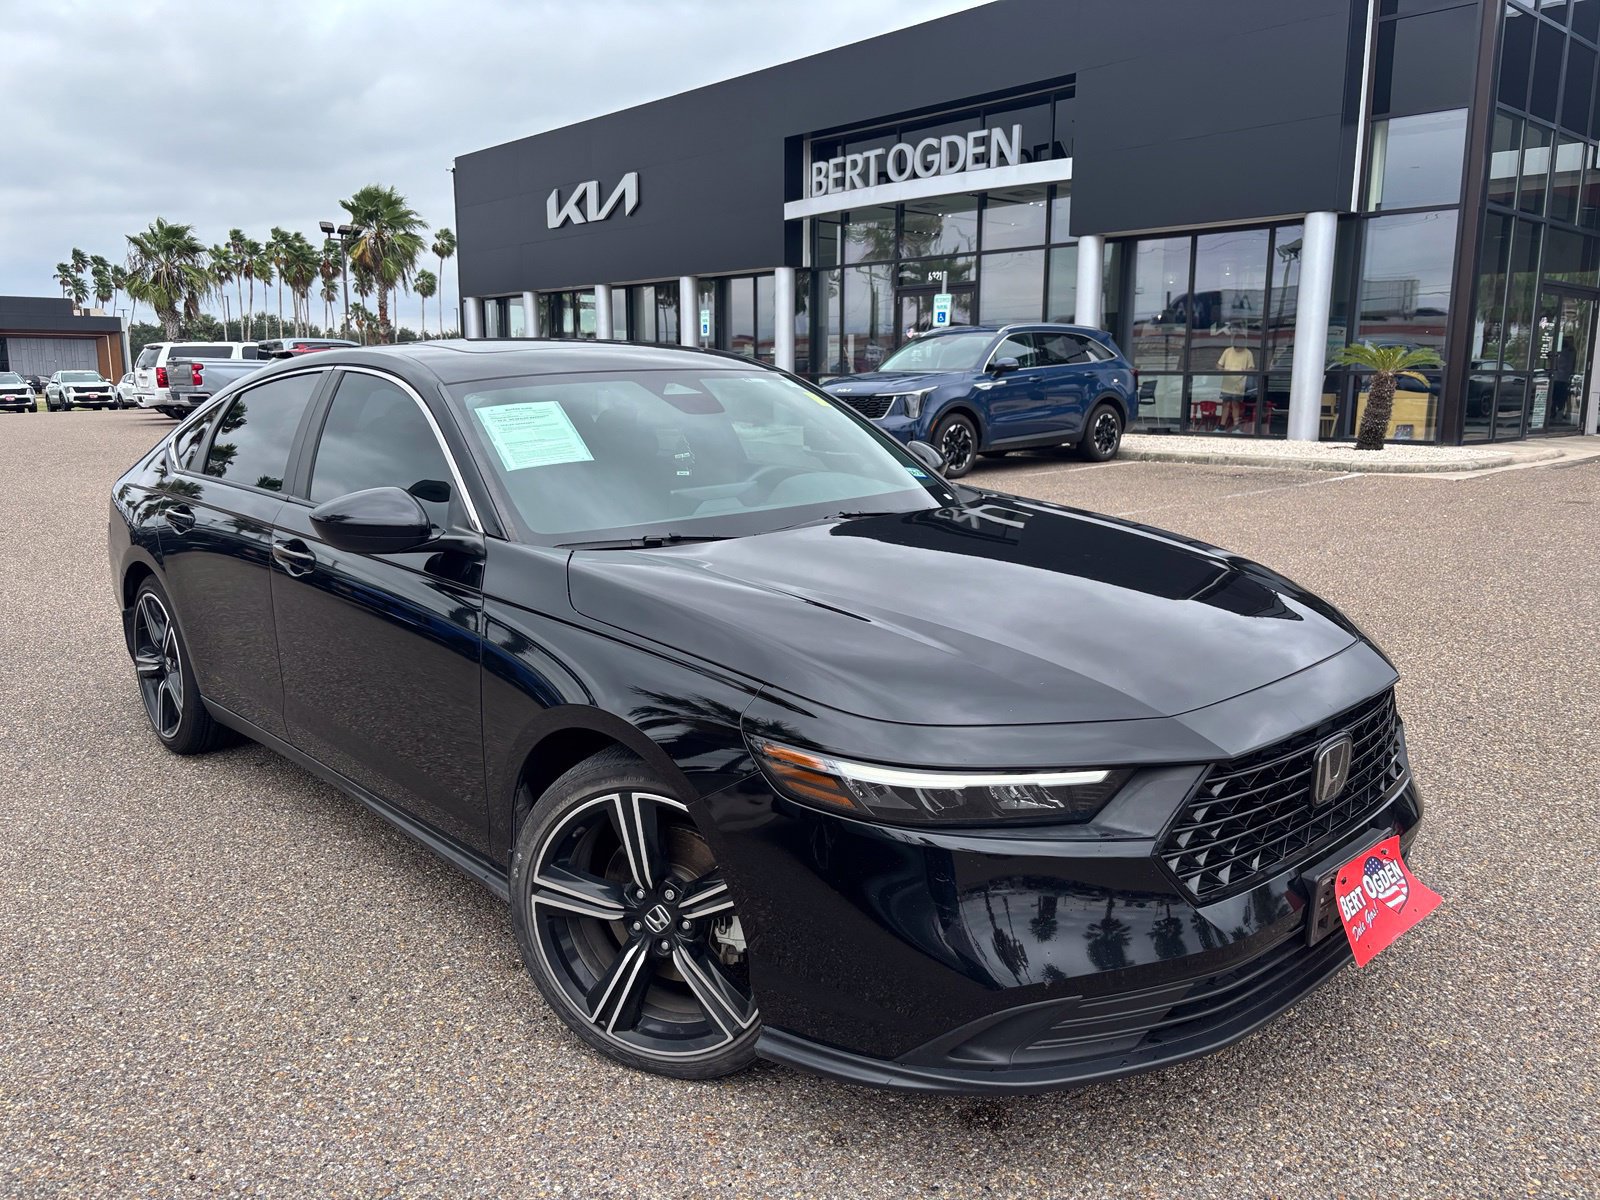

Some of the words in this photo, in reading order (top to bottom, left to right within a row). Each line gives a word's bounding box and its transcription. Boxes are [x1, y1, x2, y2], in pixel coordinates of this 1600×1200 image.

[811, 147, 885, 198] BERT
[886, 124, 1023, 183] OGDEN
[546, 171, 639, 229] KIA
[1340, 886, 1366, 922] BERT
[1362, 859, 1404, 899] OGDEN
